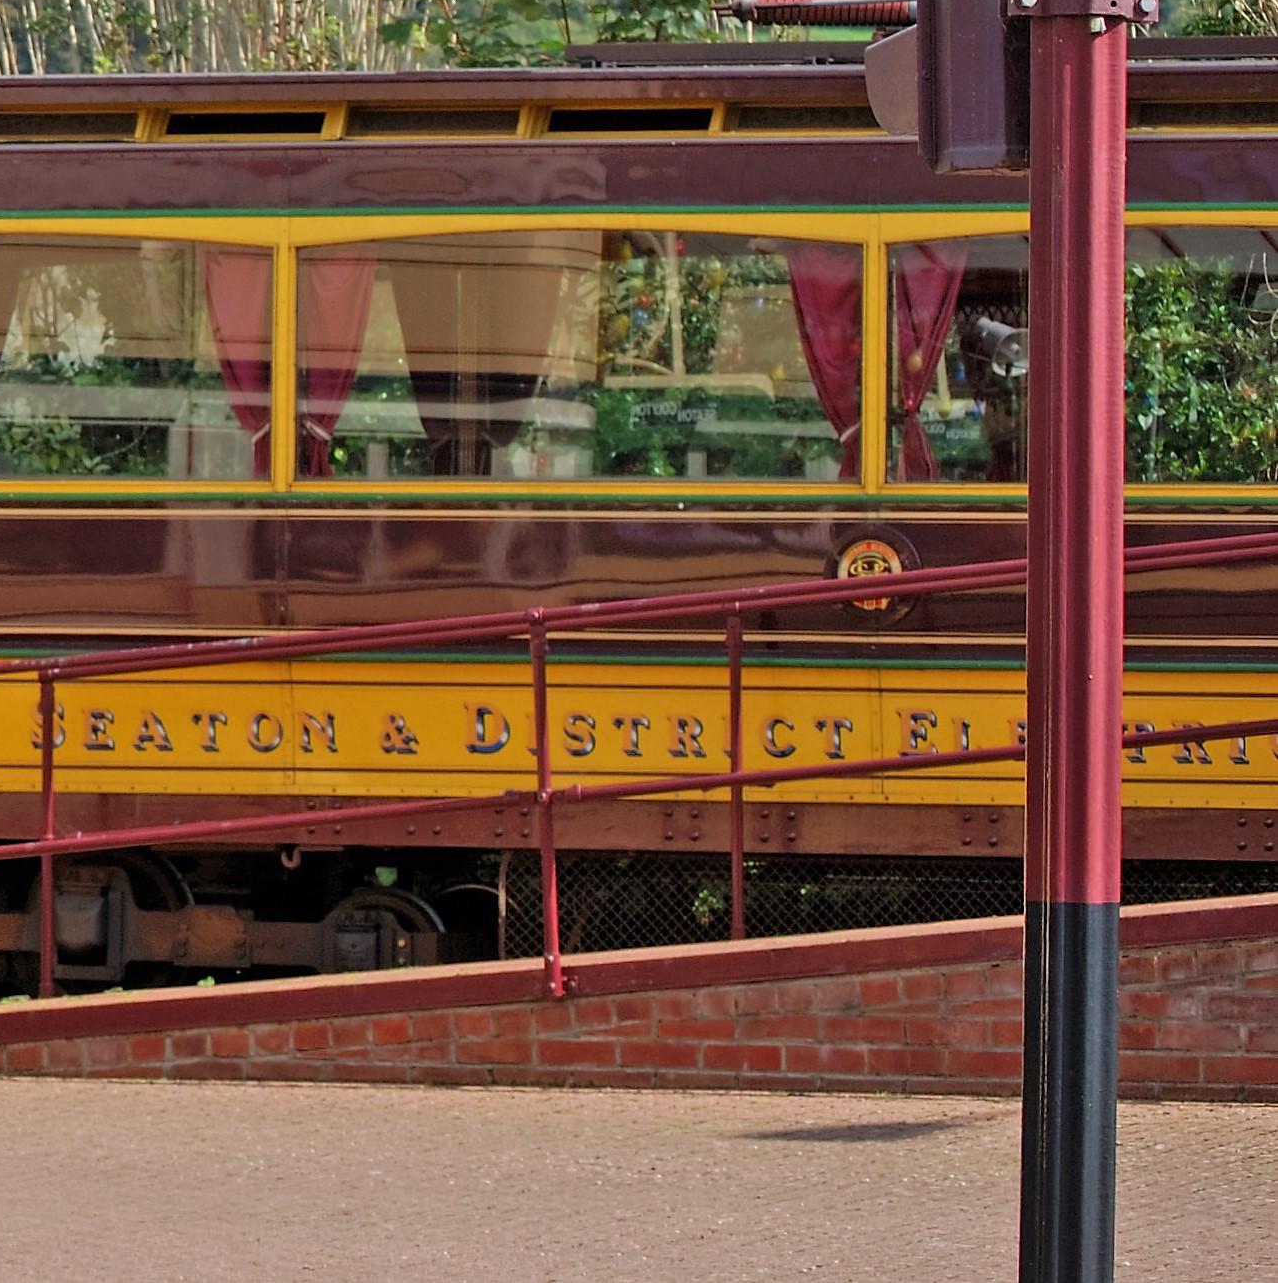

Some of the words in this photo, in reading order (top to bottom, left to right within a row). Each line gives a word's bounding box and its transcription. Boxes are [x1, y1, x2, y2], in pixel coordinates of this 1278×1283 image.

[31, 701, 338, 754] SEATON
[379, 713, 419, 755] &
[898, 707, 1278, 765] ELTRI
